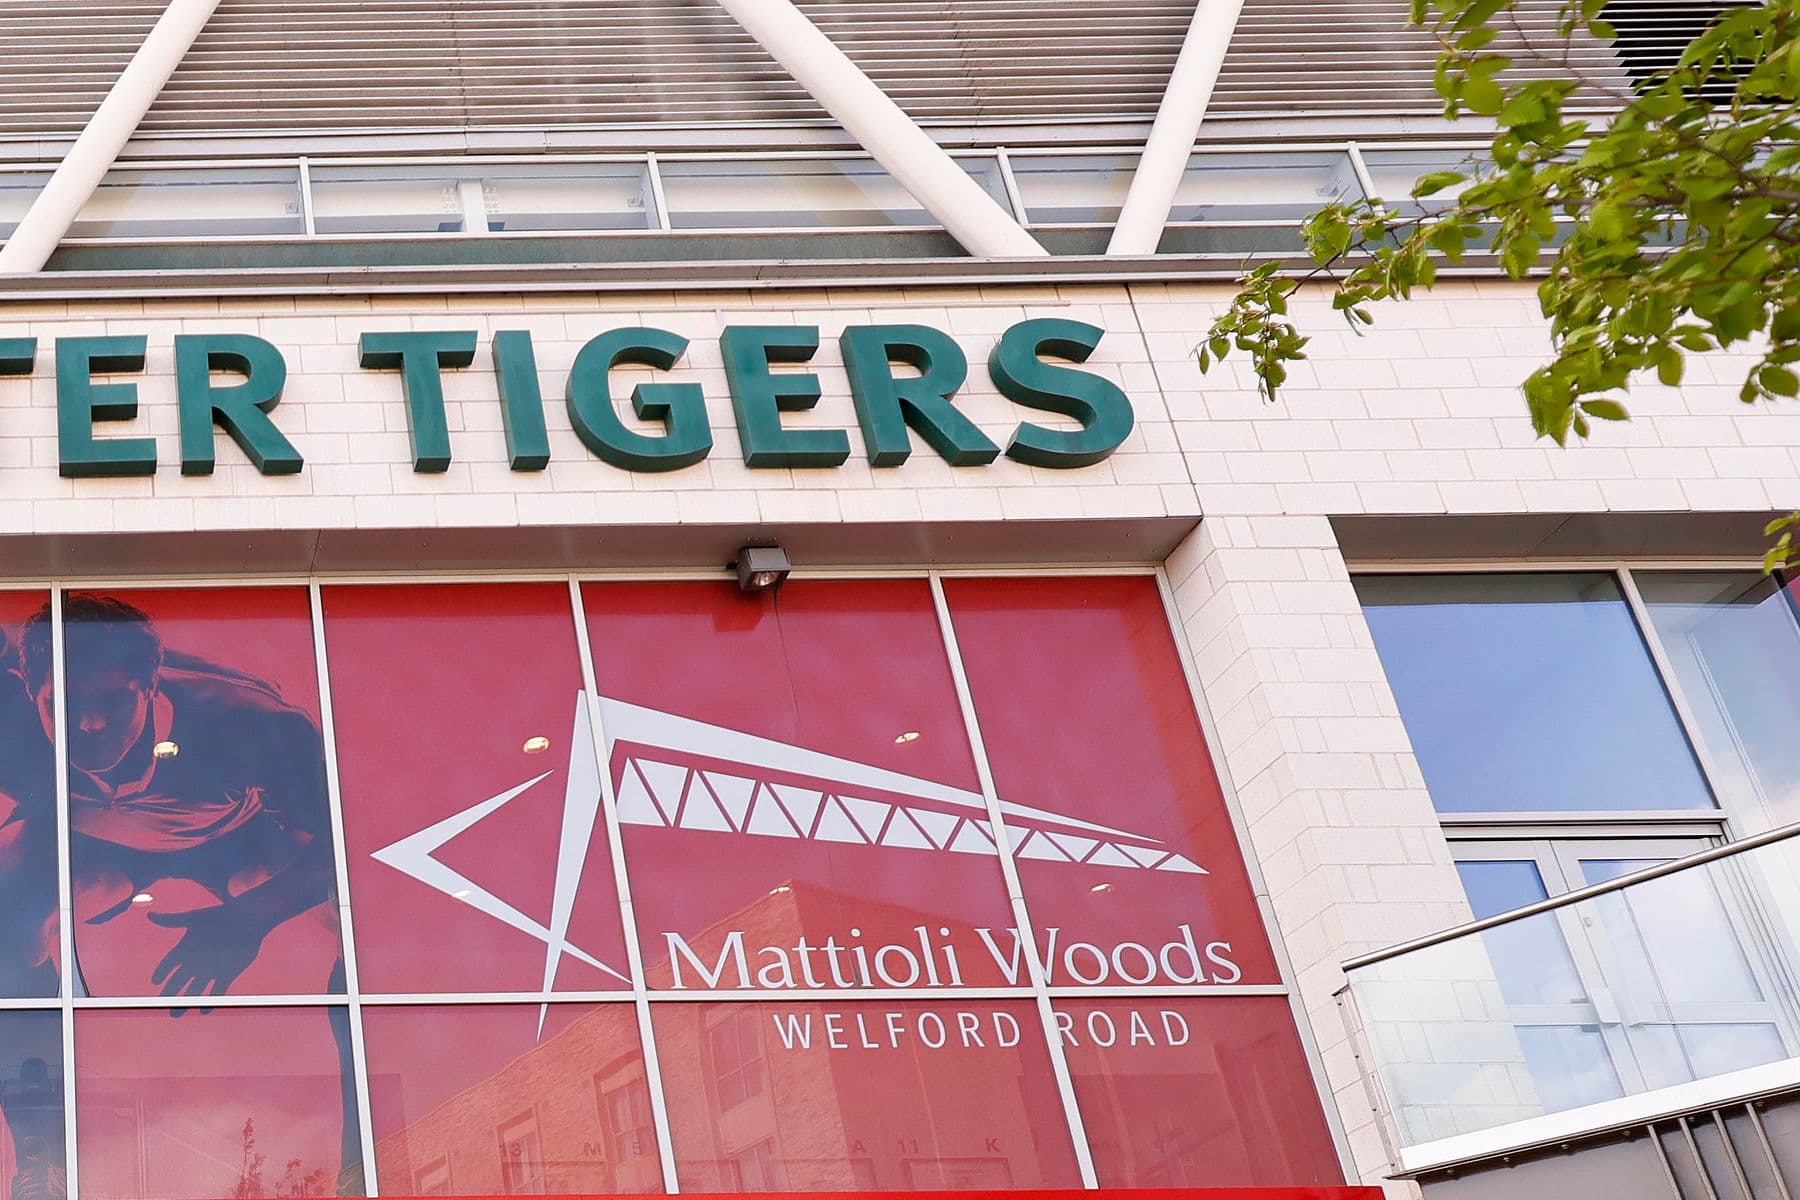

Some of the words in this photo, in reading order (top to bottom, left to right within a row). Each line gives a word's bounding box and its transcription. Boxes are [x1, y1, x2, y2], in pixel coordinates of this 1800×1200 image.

[358, 318, 1138, 474] TIGERS
[661, 924, 964, 992] Mattioli
[974, 922, 1243, 987] Woods
[773, 1008, 1022, 1052] WELFORD
[1056, 1006, 1192, 1048] ROAD
